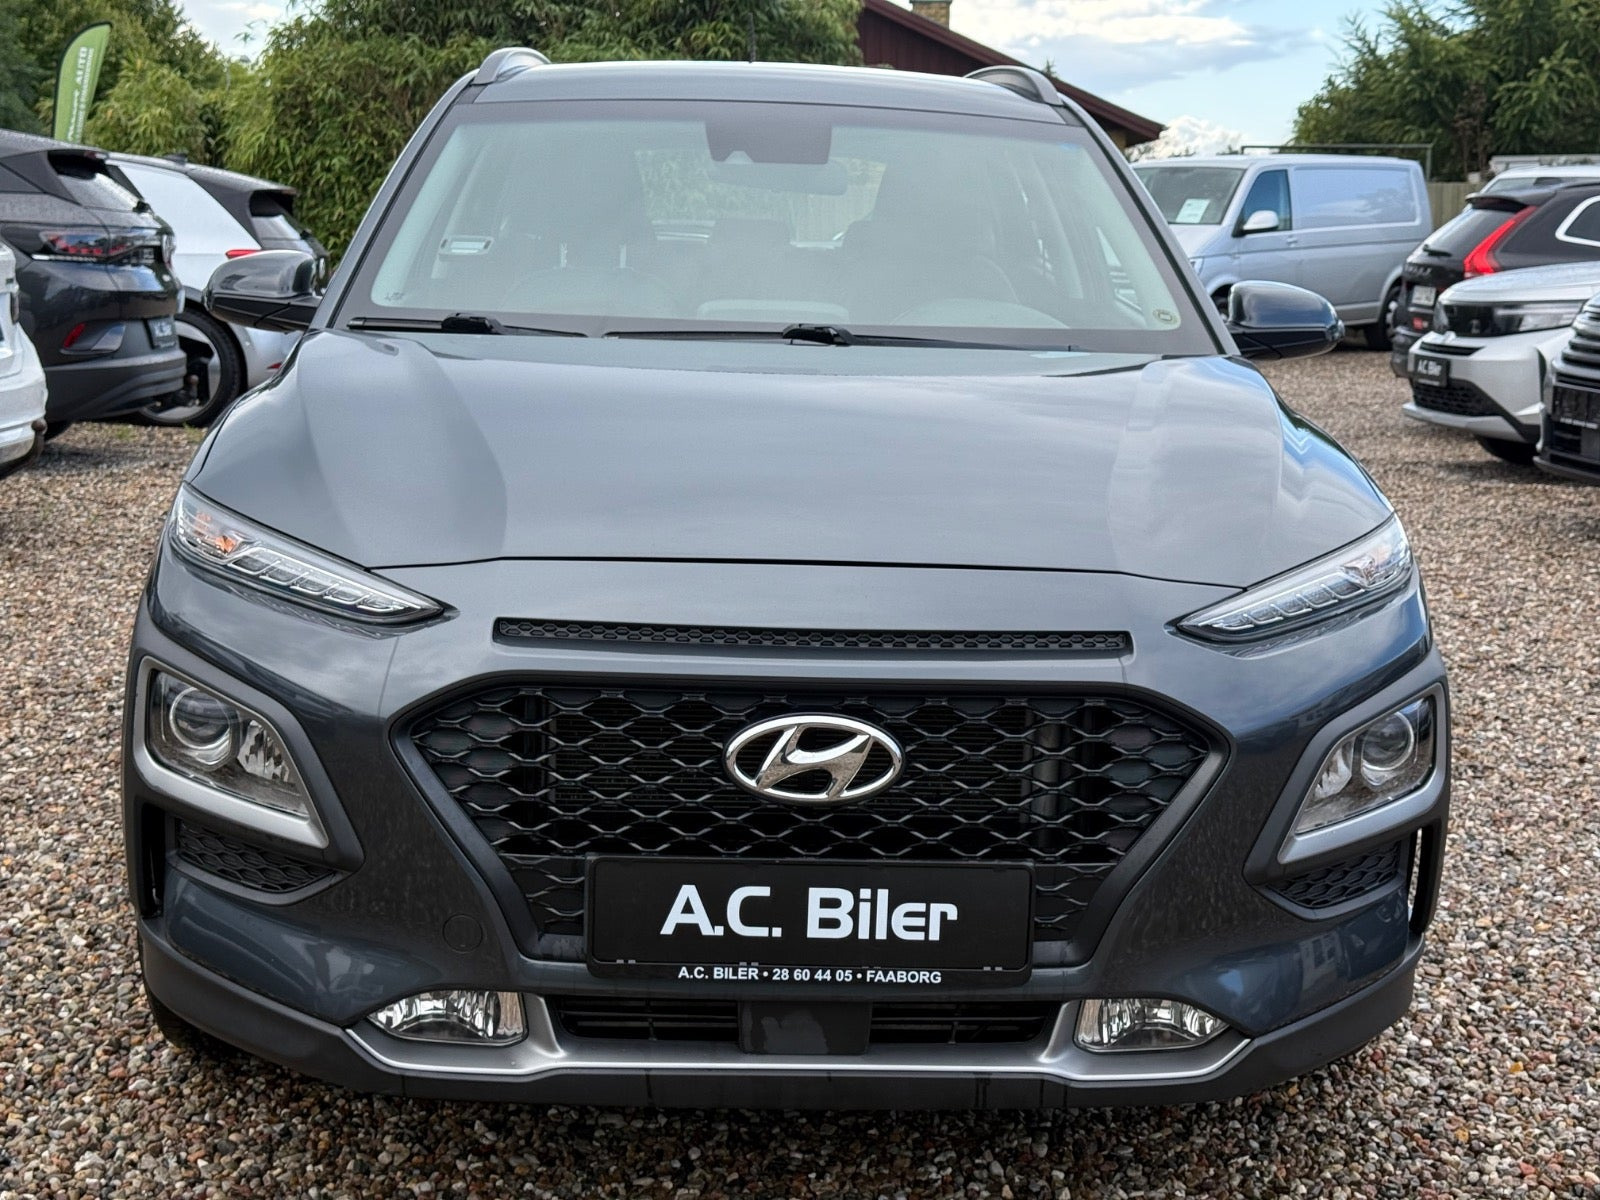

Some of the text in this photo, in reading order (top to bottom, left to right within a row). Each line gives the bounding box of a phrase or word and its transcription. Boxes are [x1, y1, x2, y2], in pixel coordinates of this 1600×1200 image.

[660, 885, 958, 941] A.C. Biler
[678, 966, 942, 984] A.C. BILER 28 60 44 05 FAABORG
